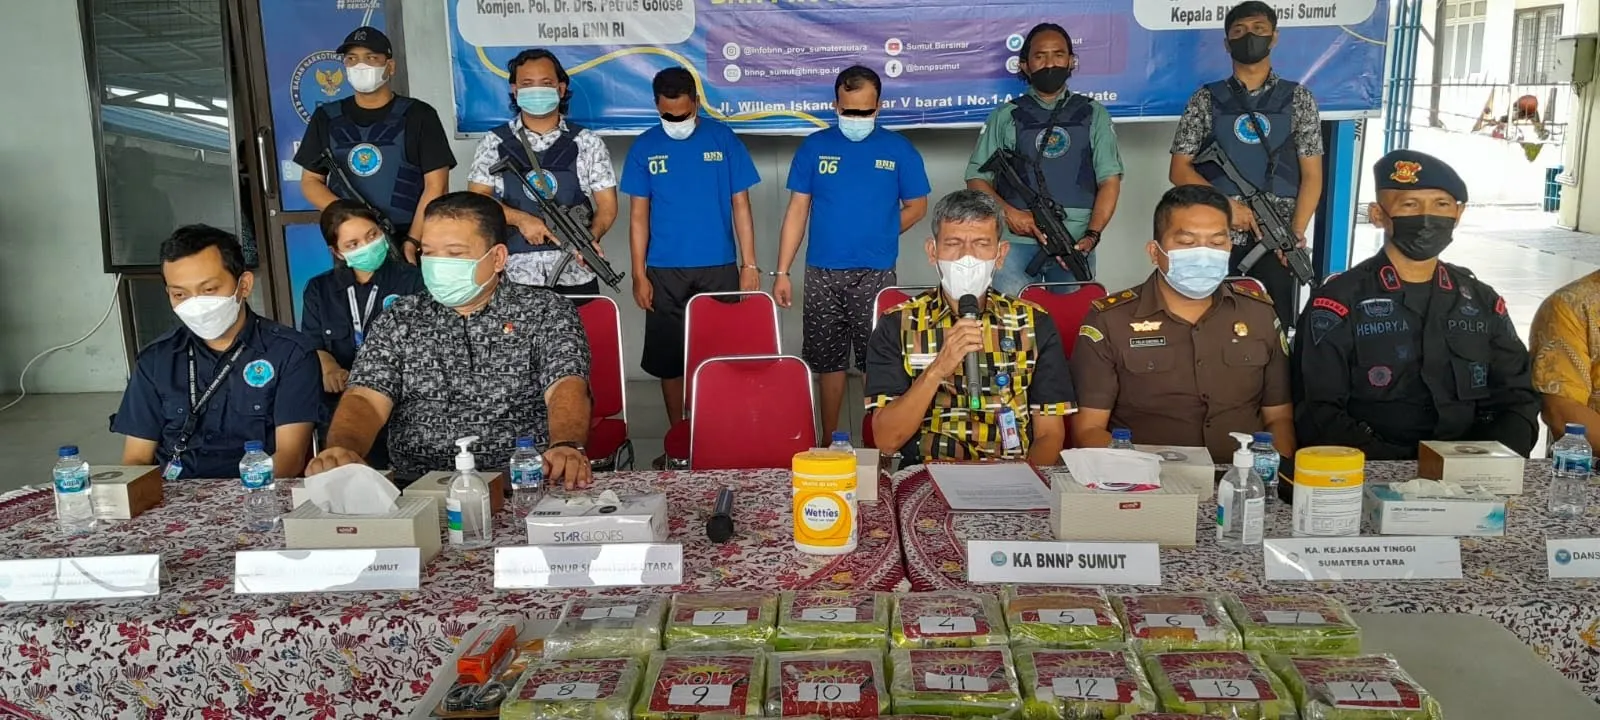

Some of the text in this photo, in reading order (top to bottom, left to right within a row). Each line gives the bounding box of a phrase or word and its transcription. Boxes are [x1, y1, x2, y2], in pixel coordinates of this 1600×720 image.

[1171, 6, 1212, 25] Kepala
[1297, 4, 1337, 19] Sumut
[538, 22, 625, 41] Kepala BNN RI
[934, 41, 969, 49] Bersinar
[905, 62, 960, 72] @bnnpsumut
[738, 101, 786, 112] Willem
[901, 98, 910, 108] V
[915, 96, 953, 107] barat
[648, 160, 668, 175] 01
[818, 160, 838, 174] 06
[875, 160, 896, 169] BNN
[1448, 319, 1489, 333] POLRI
[804, 507, 839, 518] Wetties
[1323, 546, 1380, 554] KEJAKSAAN
[1382, 545, 1416, 553] TINGGI
[367, 563, 399, 571] SUMUT
[1013, 552, 1127, 570] KA BNNP SUMUT
[1318, 559, 1370, 567] SUMATERA
[606, 607, 613, 617] 1
[711, 612, 725, 624] 2
[819, 609, 838, 620] 3
[1058, 611, 1075, 624] 5
[938, 617, 955, 631] 4
[1165, 615, 1182, 626] 6
[557, 683, 577, 696] 8
[947, 676, 966, 690] 11
[1074, 678, 1100, 697] 12
[1213, 681, 1240, 698] 13
[692, 686, 709, 704] 9
[814, 684, 842, 700] 10
[1350, 681, 1380, 700] 14
